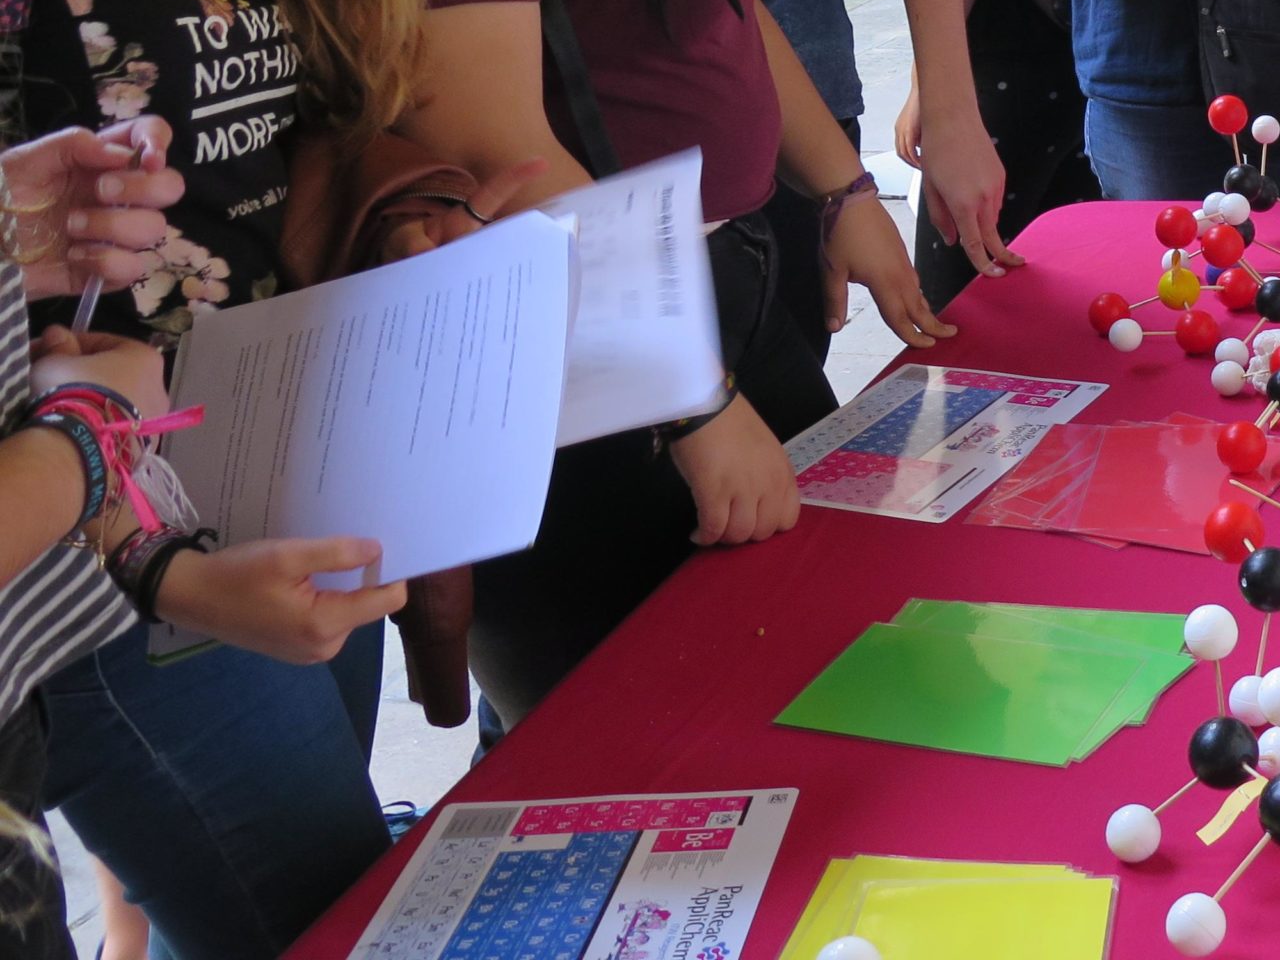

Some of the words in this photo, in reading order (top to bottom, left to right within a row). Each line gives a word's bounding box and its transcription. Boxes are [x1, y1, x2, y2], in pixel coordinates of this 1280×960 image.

[175, 15, 228, 53] TO
[681, 832, 714, 848] Be
[702, 885, 744, 943] PanReac
